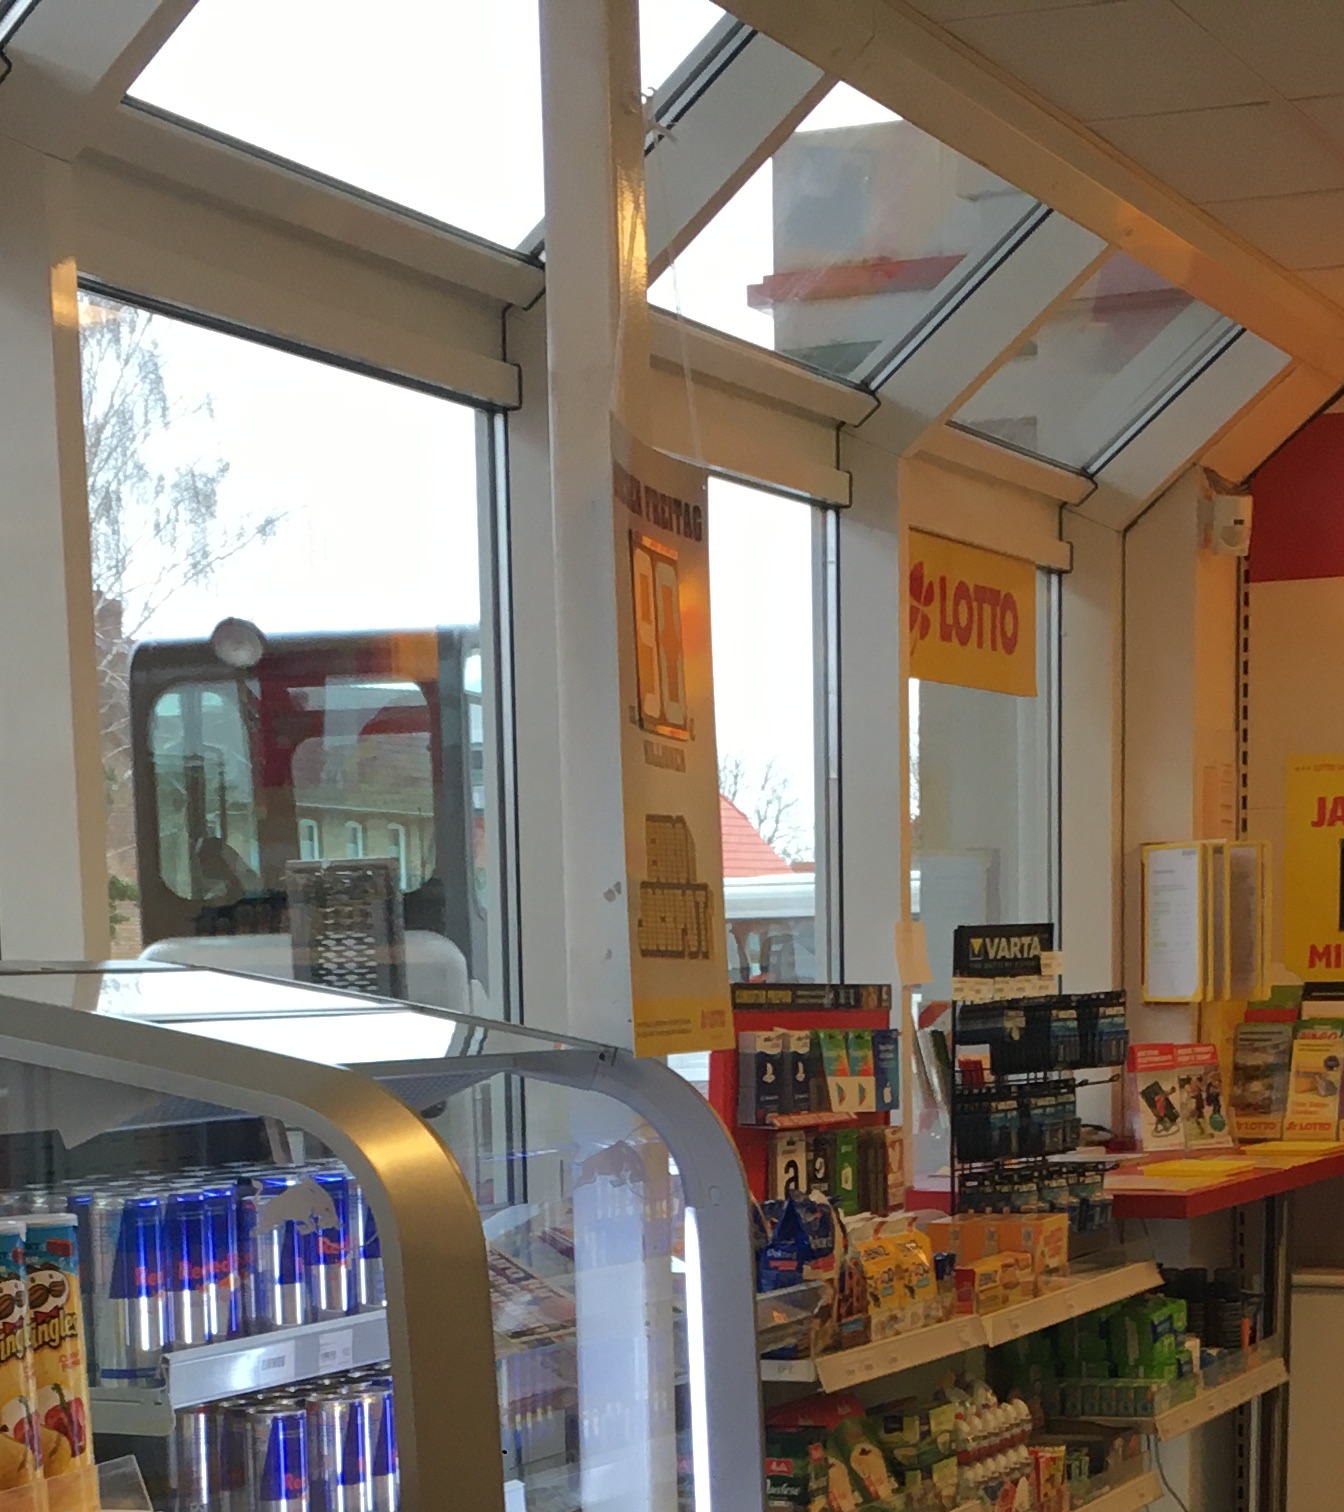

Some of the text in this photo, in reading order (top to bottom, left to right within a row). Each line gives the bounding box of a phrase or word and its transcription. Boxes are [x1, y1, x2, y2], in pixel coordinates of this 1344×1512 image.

[939, 575, 1019, 656] LOTTO
[985, 936, 1041, 960] VARTA
[1245, 1121, 1277, 1131] LOTTO
[1299, 1122, 1332, 1131] LOTTO
[27, 1311, 80, 1353] ingles
